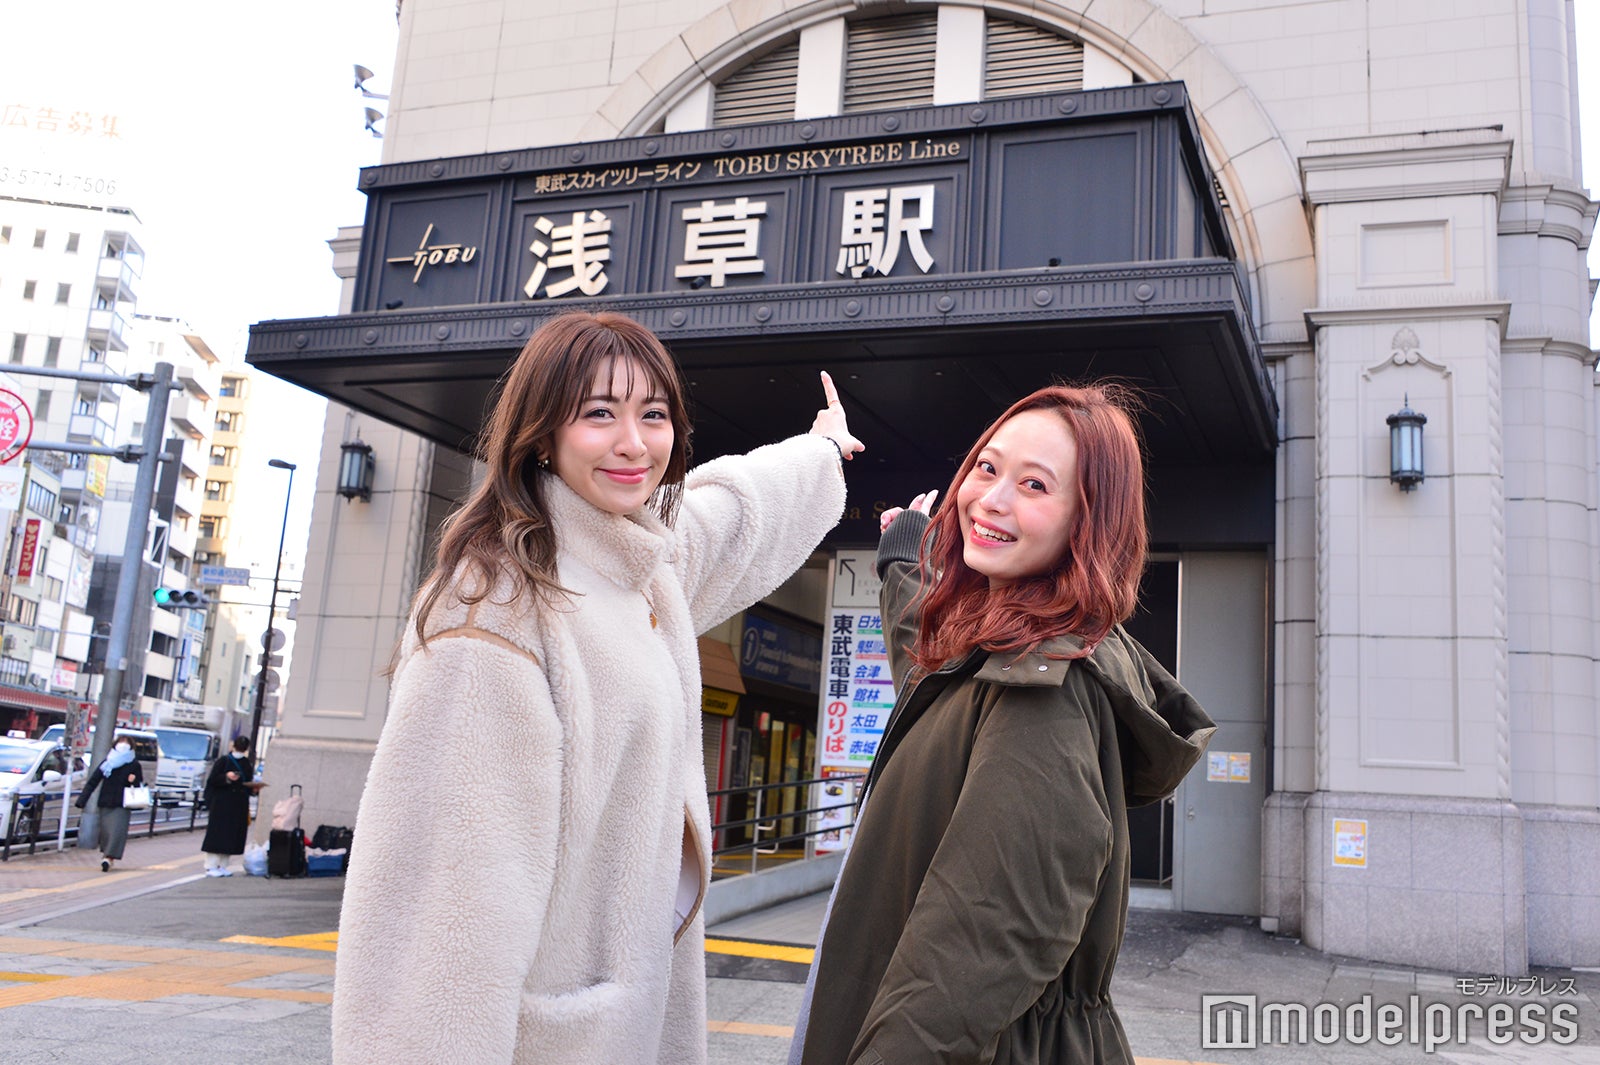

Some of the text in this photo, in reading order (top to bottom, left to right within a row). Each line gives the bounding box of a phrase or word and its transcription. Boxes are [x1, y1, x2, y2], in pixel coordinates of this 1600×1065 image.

[1, 103, 123, 140] 広告募集
[714, 139, 961, 178] TOBU SKYTREE Line
[534, 161, 701, 194] 東武スカイツリーライン
[523, 184, 936, 299] 浅草駅
[413, 246, 477, 266] TOBU
[20, 534, 37, 572] アイフル
[858, 615, 881, 628] 日光
[825, 614, 854, 752] 東武電車のりば
[854, 664, 881, 679] 会津
[853, 687, 880, 702] 館林
[850, 713, 878, 728] 太田
[849, 740, 877, 754] 赤城
